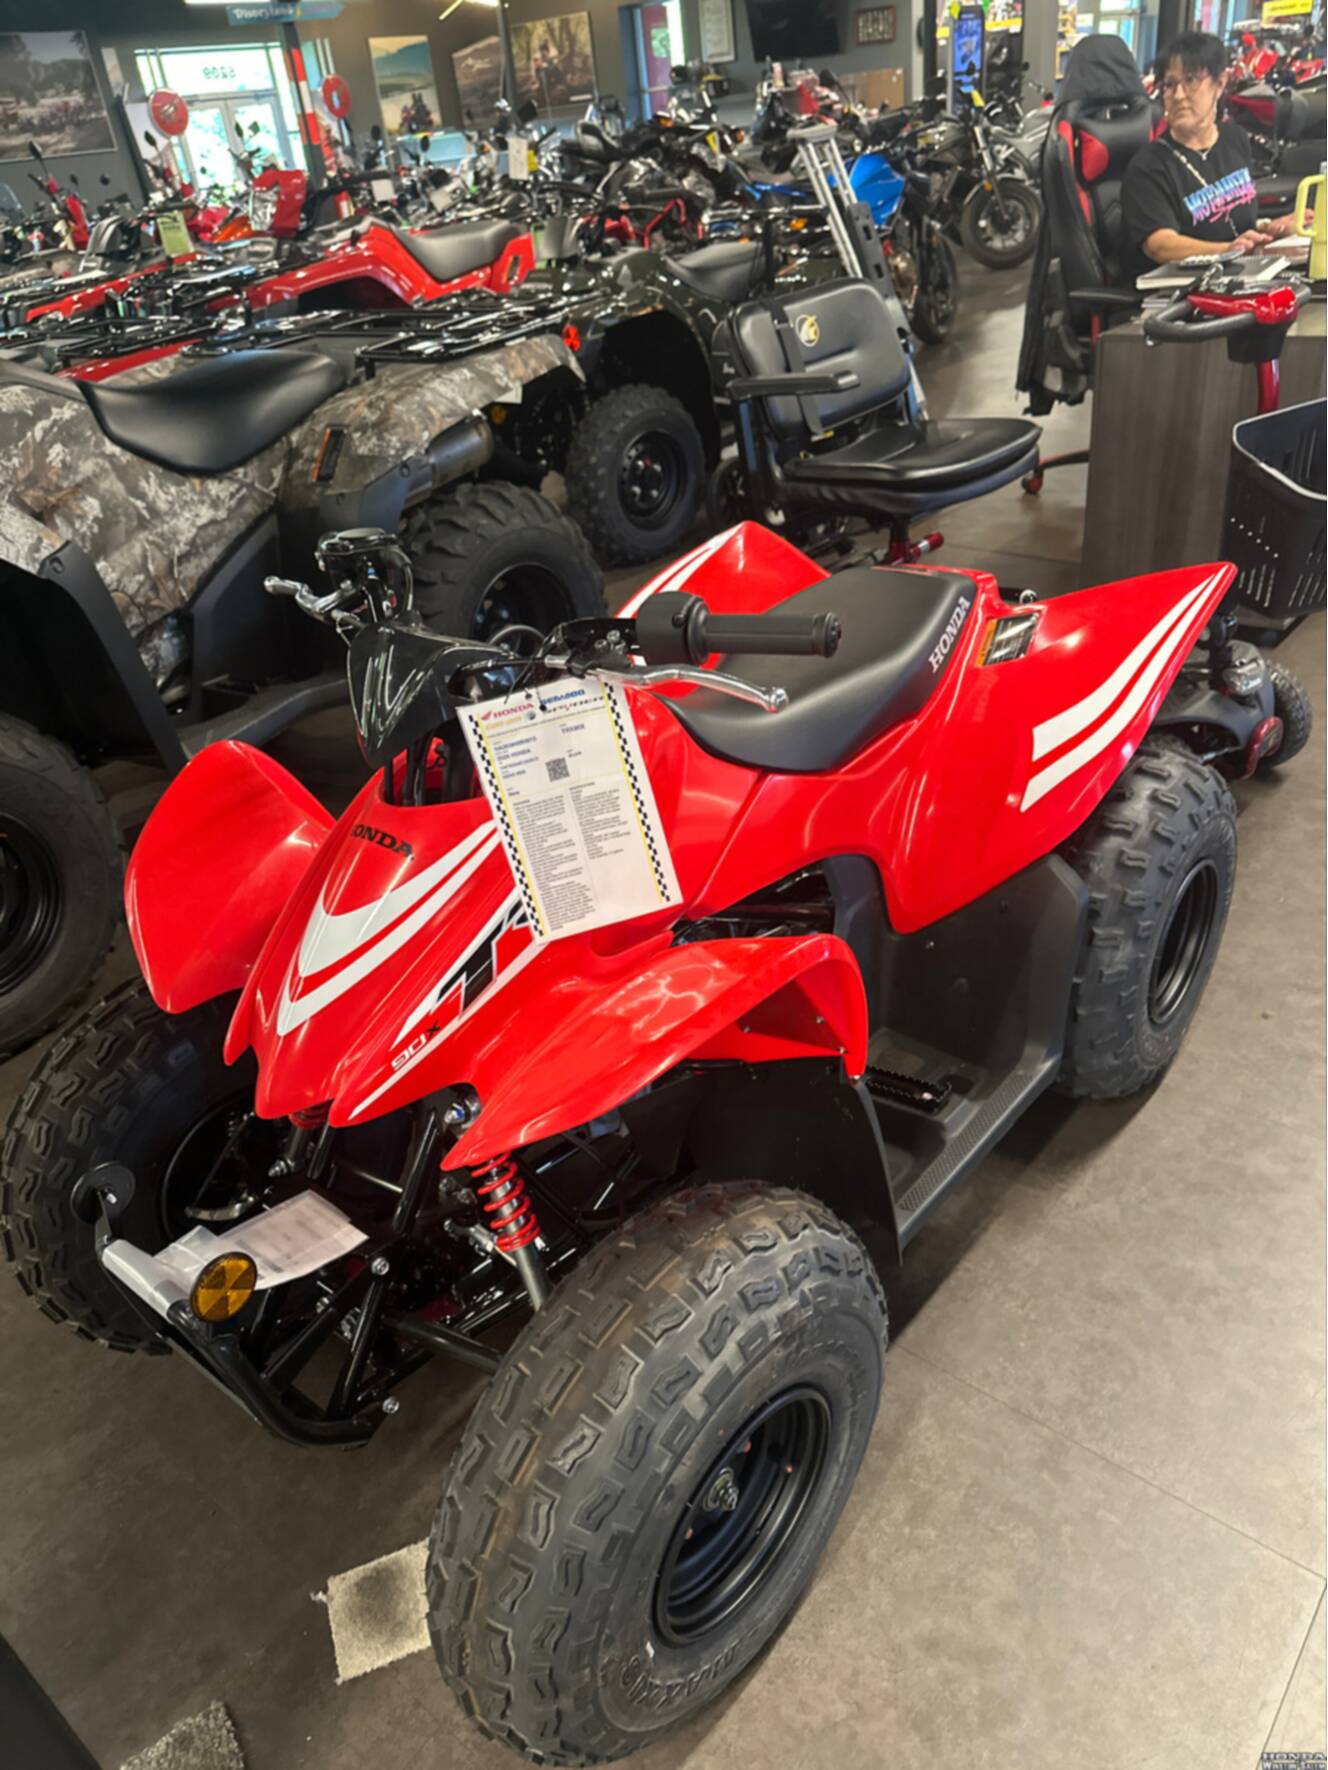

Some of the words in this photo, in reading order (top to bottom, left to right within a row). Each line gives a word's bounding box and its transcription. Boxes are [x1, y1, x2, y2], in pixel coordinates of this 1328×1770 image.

[928, 597, 971, 673] HONDA
[493, 702, 534, 719] HONDA
[350, 823, 414, 860] ONDA
